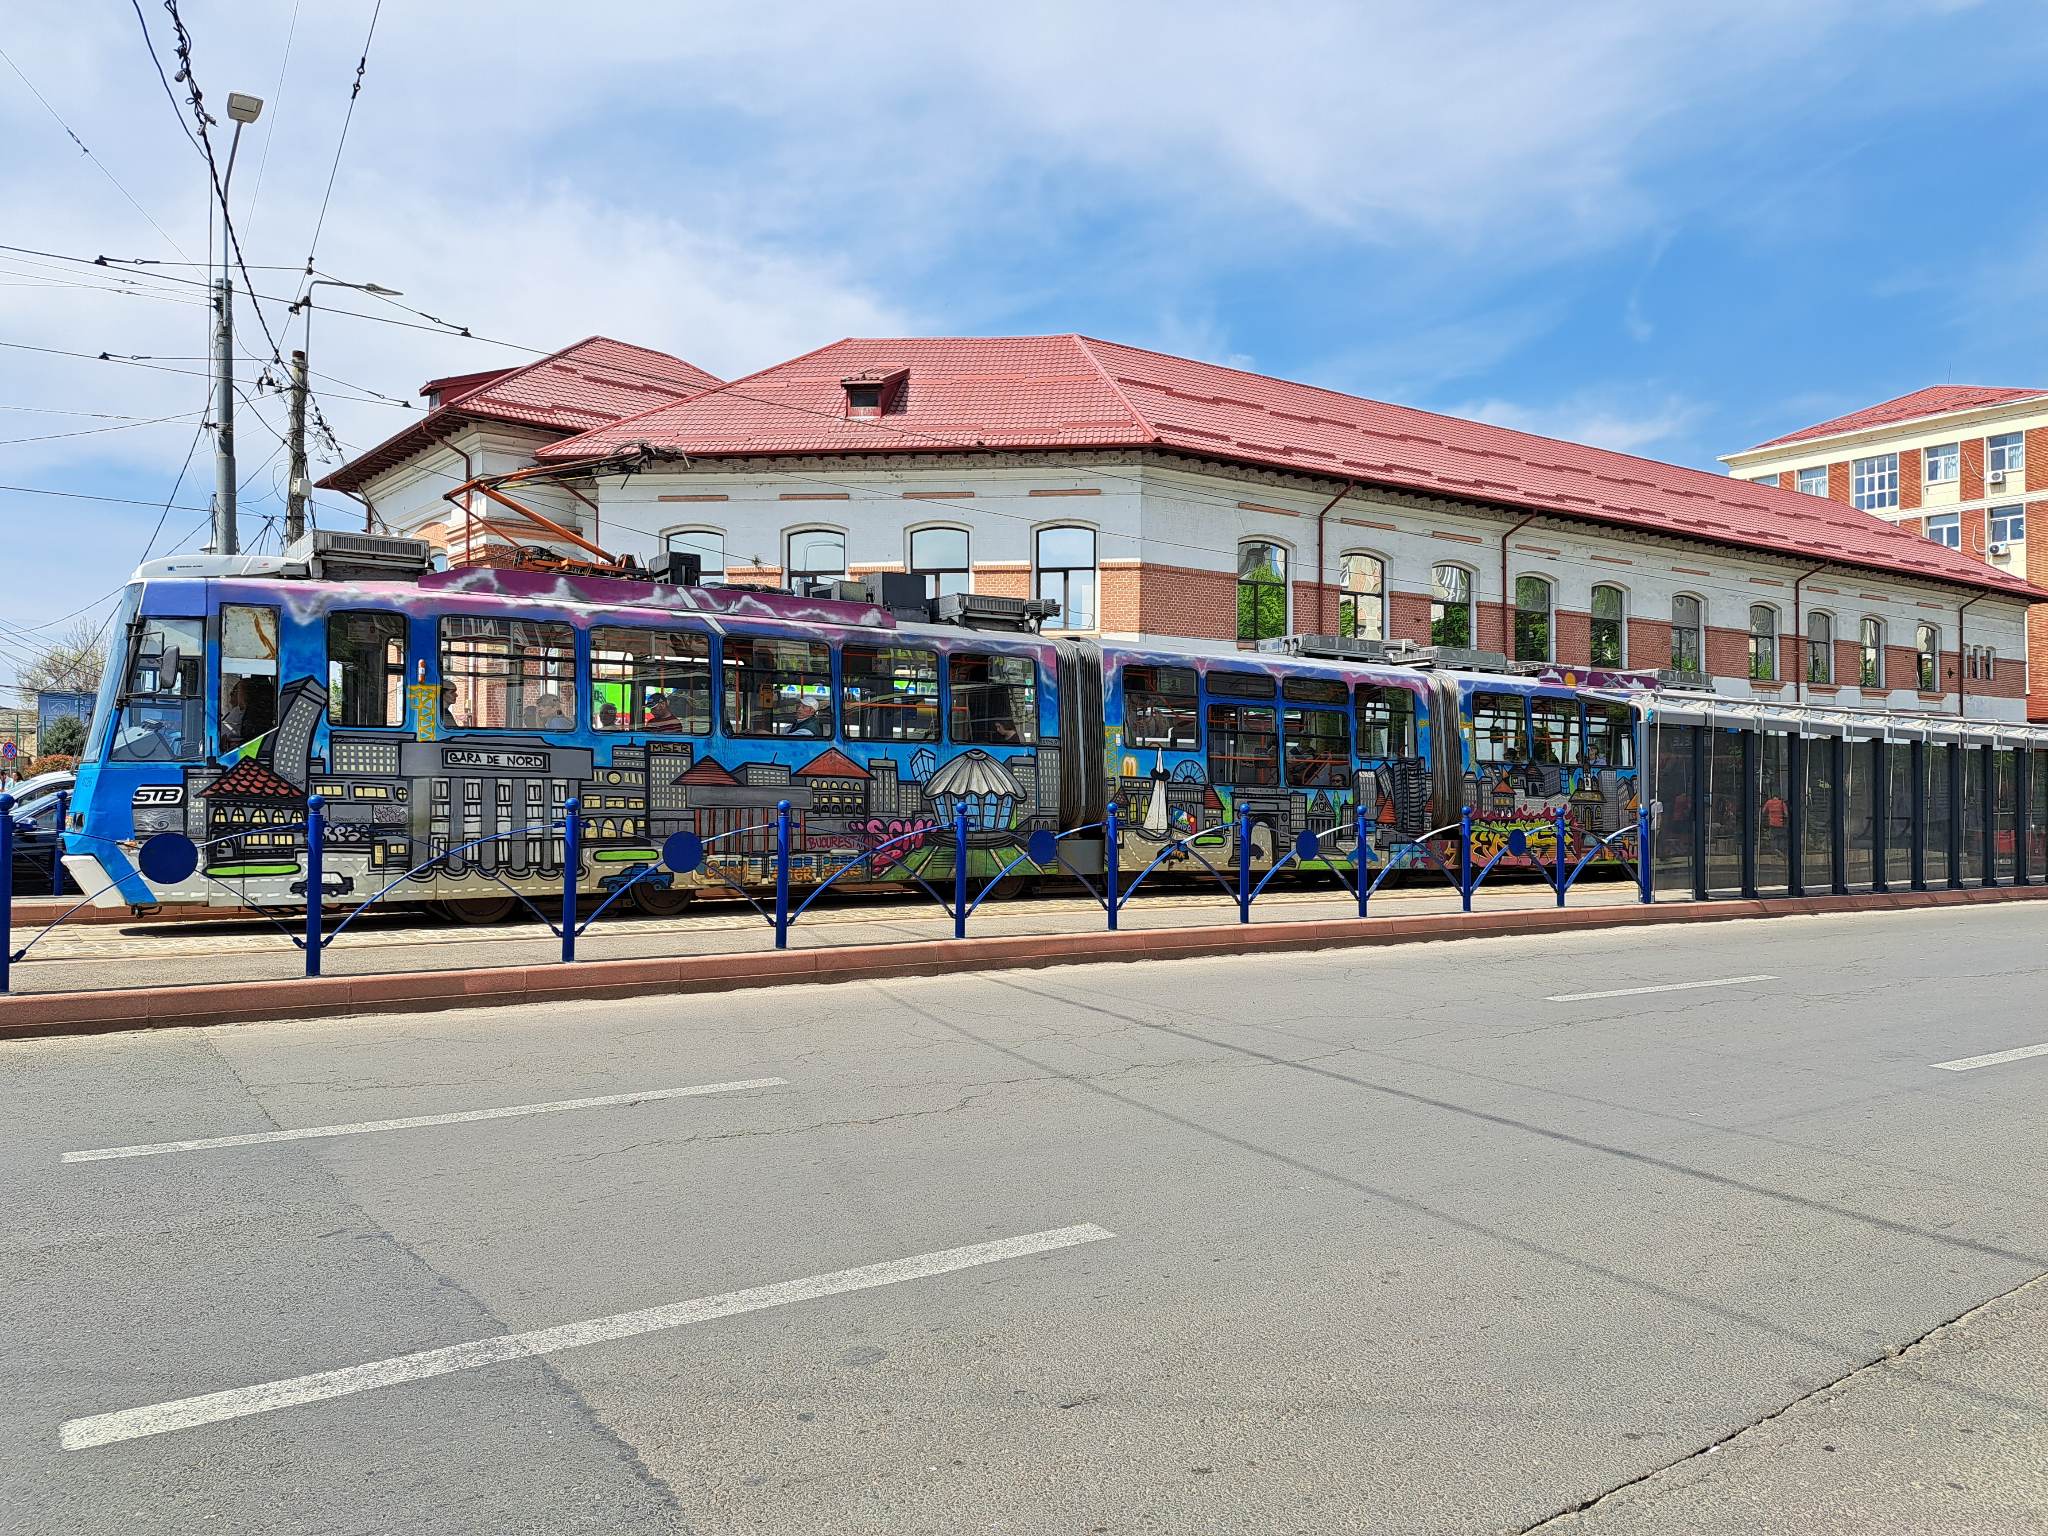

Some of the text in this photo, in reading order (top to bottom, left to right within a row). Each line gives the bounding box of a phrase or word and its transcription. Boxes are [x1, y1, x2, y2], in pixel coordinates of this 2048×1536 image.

[449, 752, 543, 766] GARA DE NORD
[131, 788, 181, 802] STB
